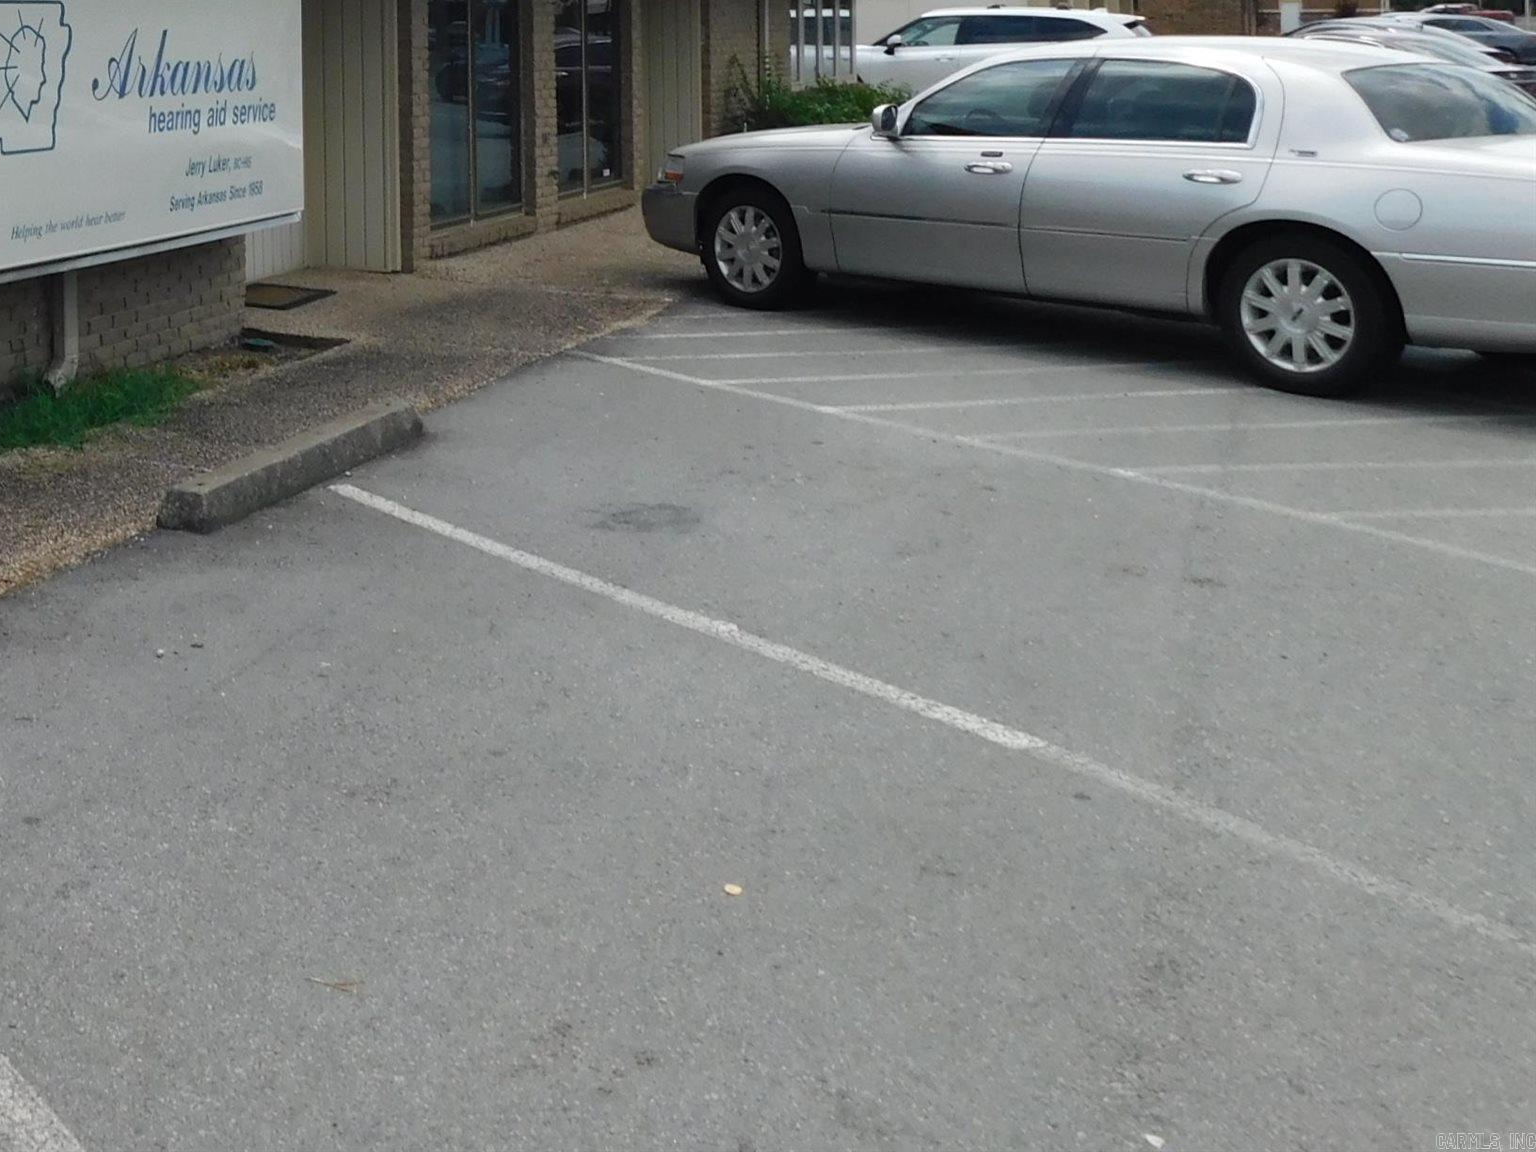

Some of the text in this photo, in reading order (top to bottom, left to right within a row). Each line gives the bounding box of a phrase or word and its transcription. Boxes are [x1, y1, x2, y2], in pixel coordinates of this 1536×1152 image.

[92, 27, 258, 101] Arkansas
[148, 97, 277, 135] hearing aid service
[185, 157, 205, 178] Jerry
[169, 195, 195, 213] Serving
[197, 189, 227, 206] Arkansas
[228, 184, 246, 201] Since
[10, 224, 43, 242] Helping
[45, 218, 58, 234] the
[60, 214, 84, 232] world
